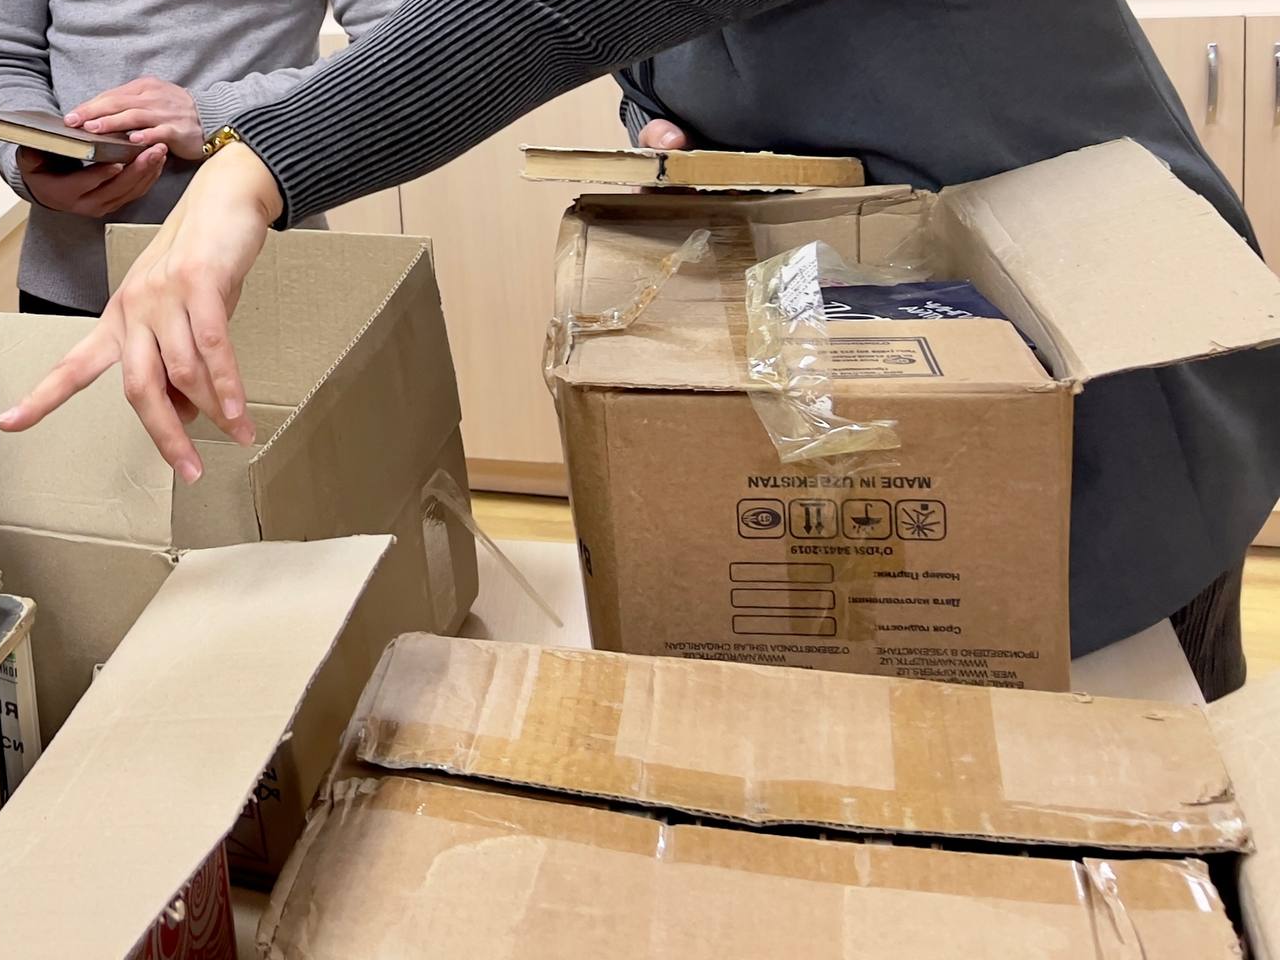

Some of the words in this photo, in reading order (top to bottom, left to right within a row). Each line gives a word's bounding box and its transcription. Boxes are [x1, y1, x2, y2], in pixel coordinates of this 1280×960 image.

[748, 475, 853, 489] UZBEKISTAN
[860, 476, 876, 488] IN
[882, 476, 931, 489] MADE
[922, 571, 960, 581] Номер
[933, 598, 960, 608] Дата
[933, 625, 962, 635] Срок
[665, 642, 731, 651] CHIQARILGAN
[733, 643, 769, 652] ISHLAB
[875, 646, 950, 657] УЗБЕКИСТАНЕ
[961, 647, 1039, 659] ПРОИЗВЕДЕНО
